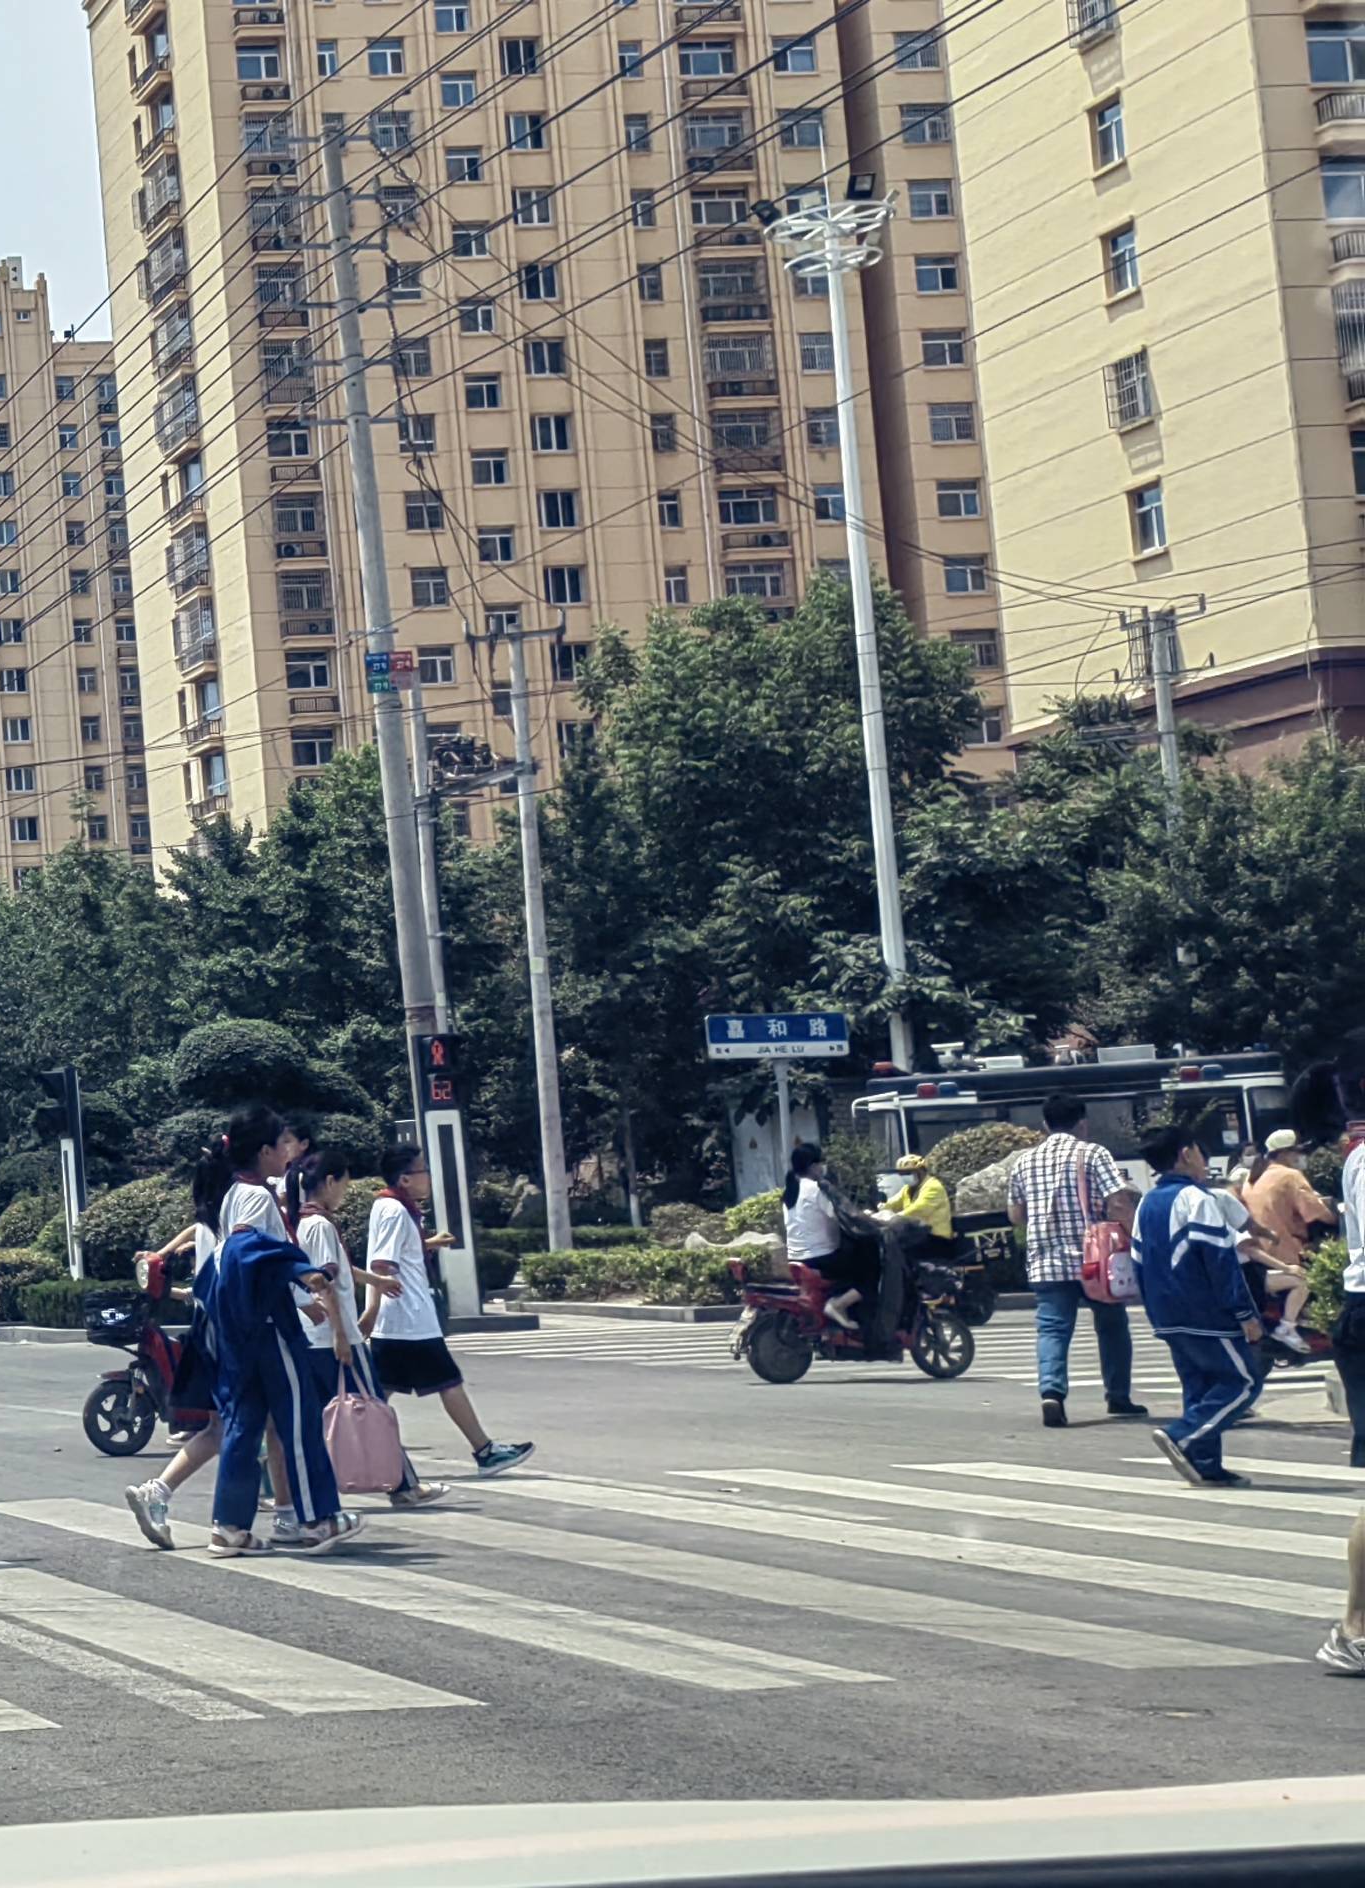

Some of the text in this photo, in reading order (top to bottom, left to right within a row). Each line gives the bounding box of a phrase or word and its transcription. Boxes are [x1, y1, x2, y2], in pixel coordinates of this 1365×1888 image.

[726, 1017, 827, 1039] 嘉和路
[431, 1081, 452, 1099] 62
